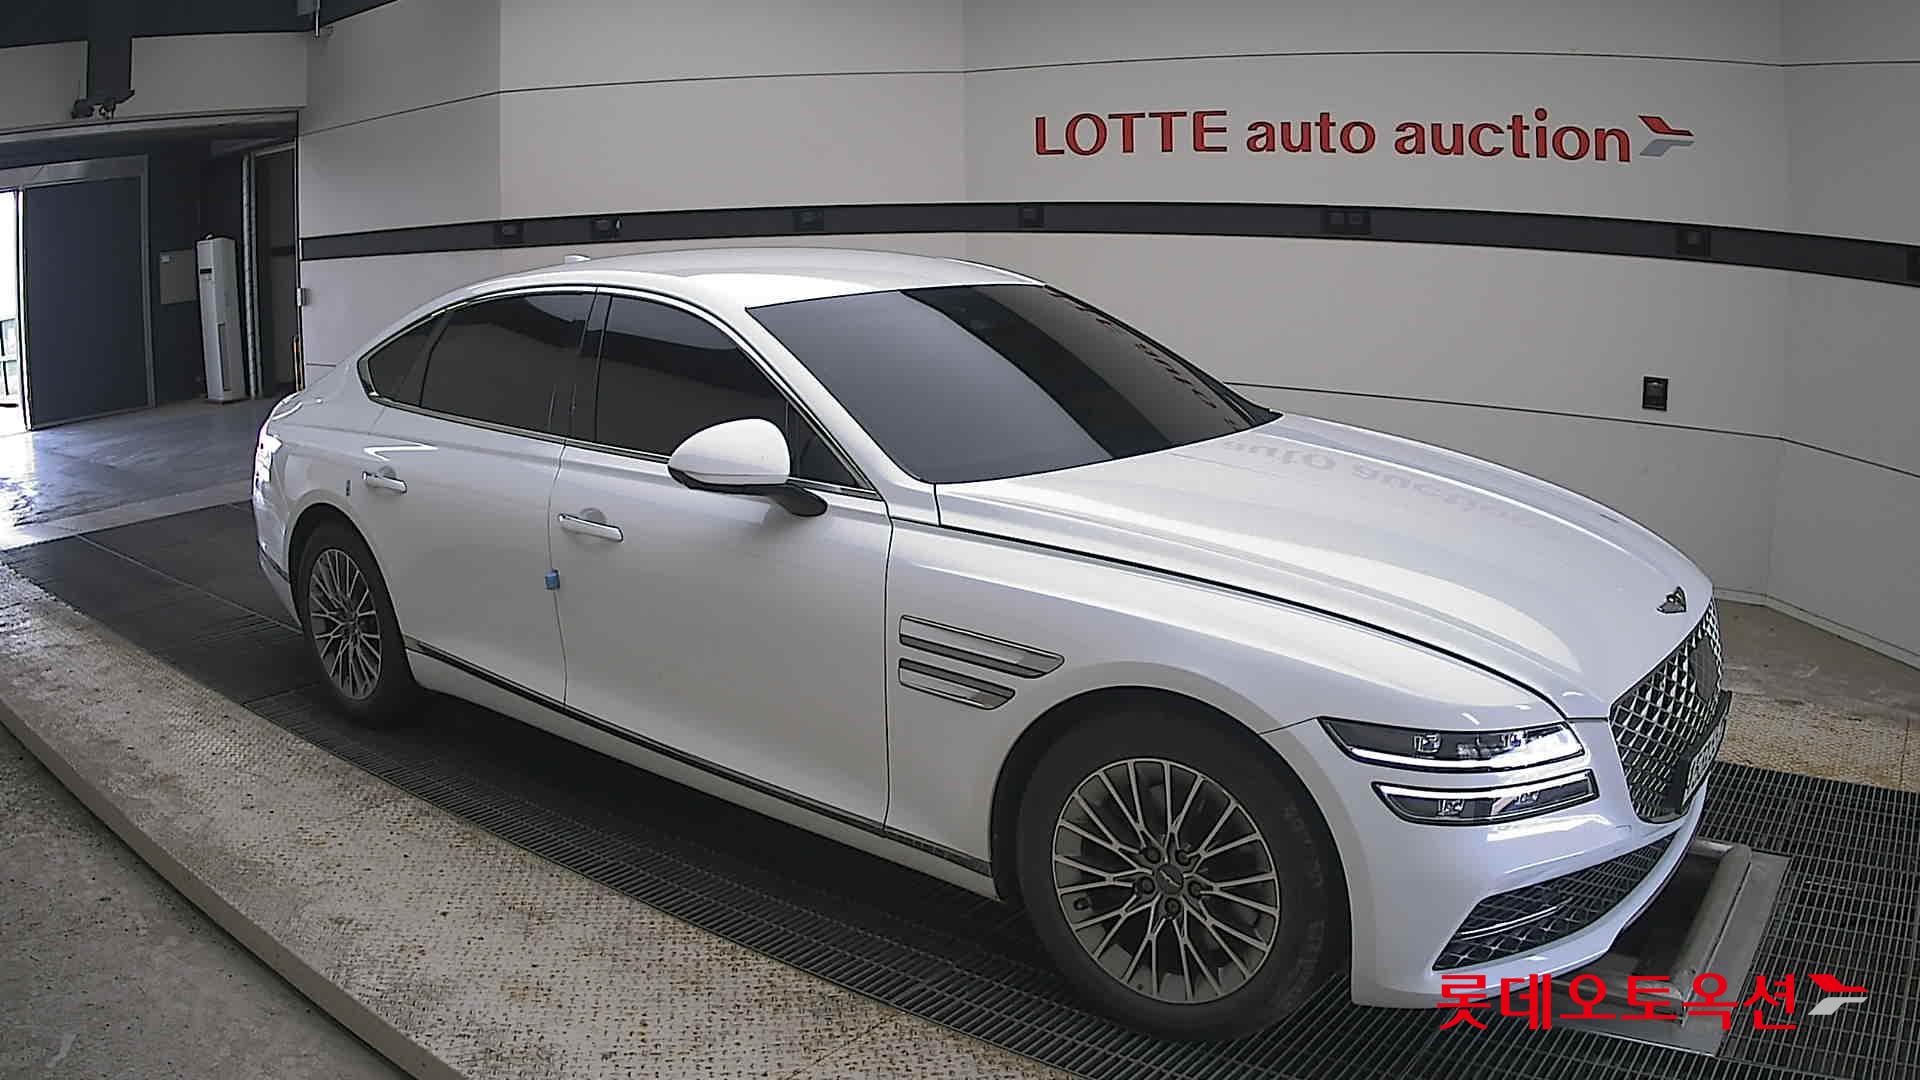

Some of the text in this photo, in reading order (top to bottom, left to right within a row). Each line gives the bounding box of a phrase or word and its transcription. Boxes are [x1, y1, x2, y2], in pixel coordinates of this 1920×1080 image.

[1034, 107, 1632, 163] LOTTE auto auction
